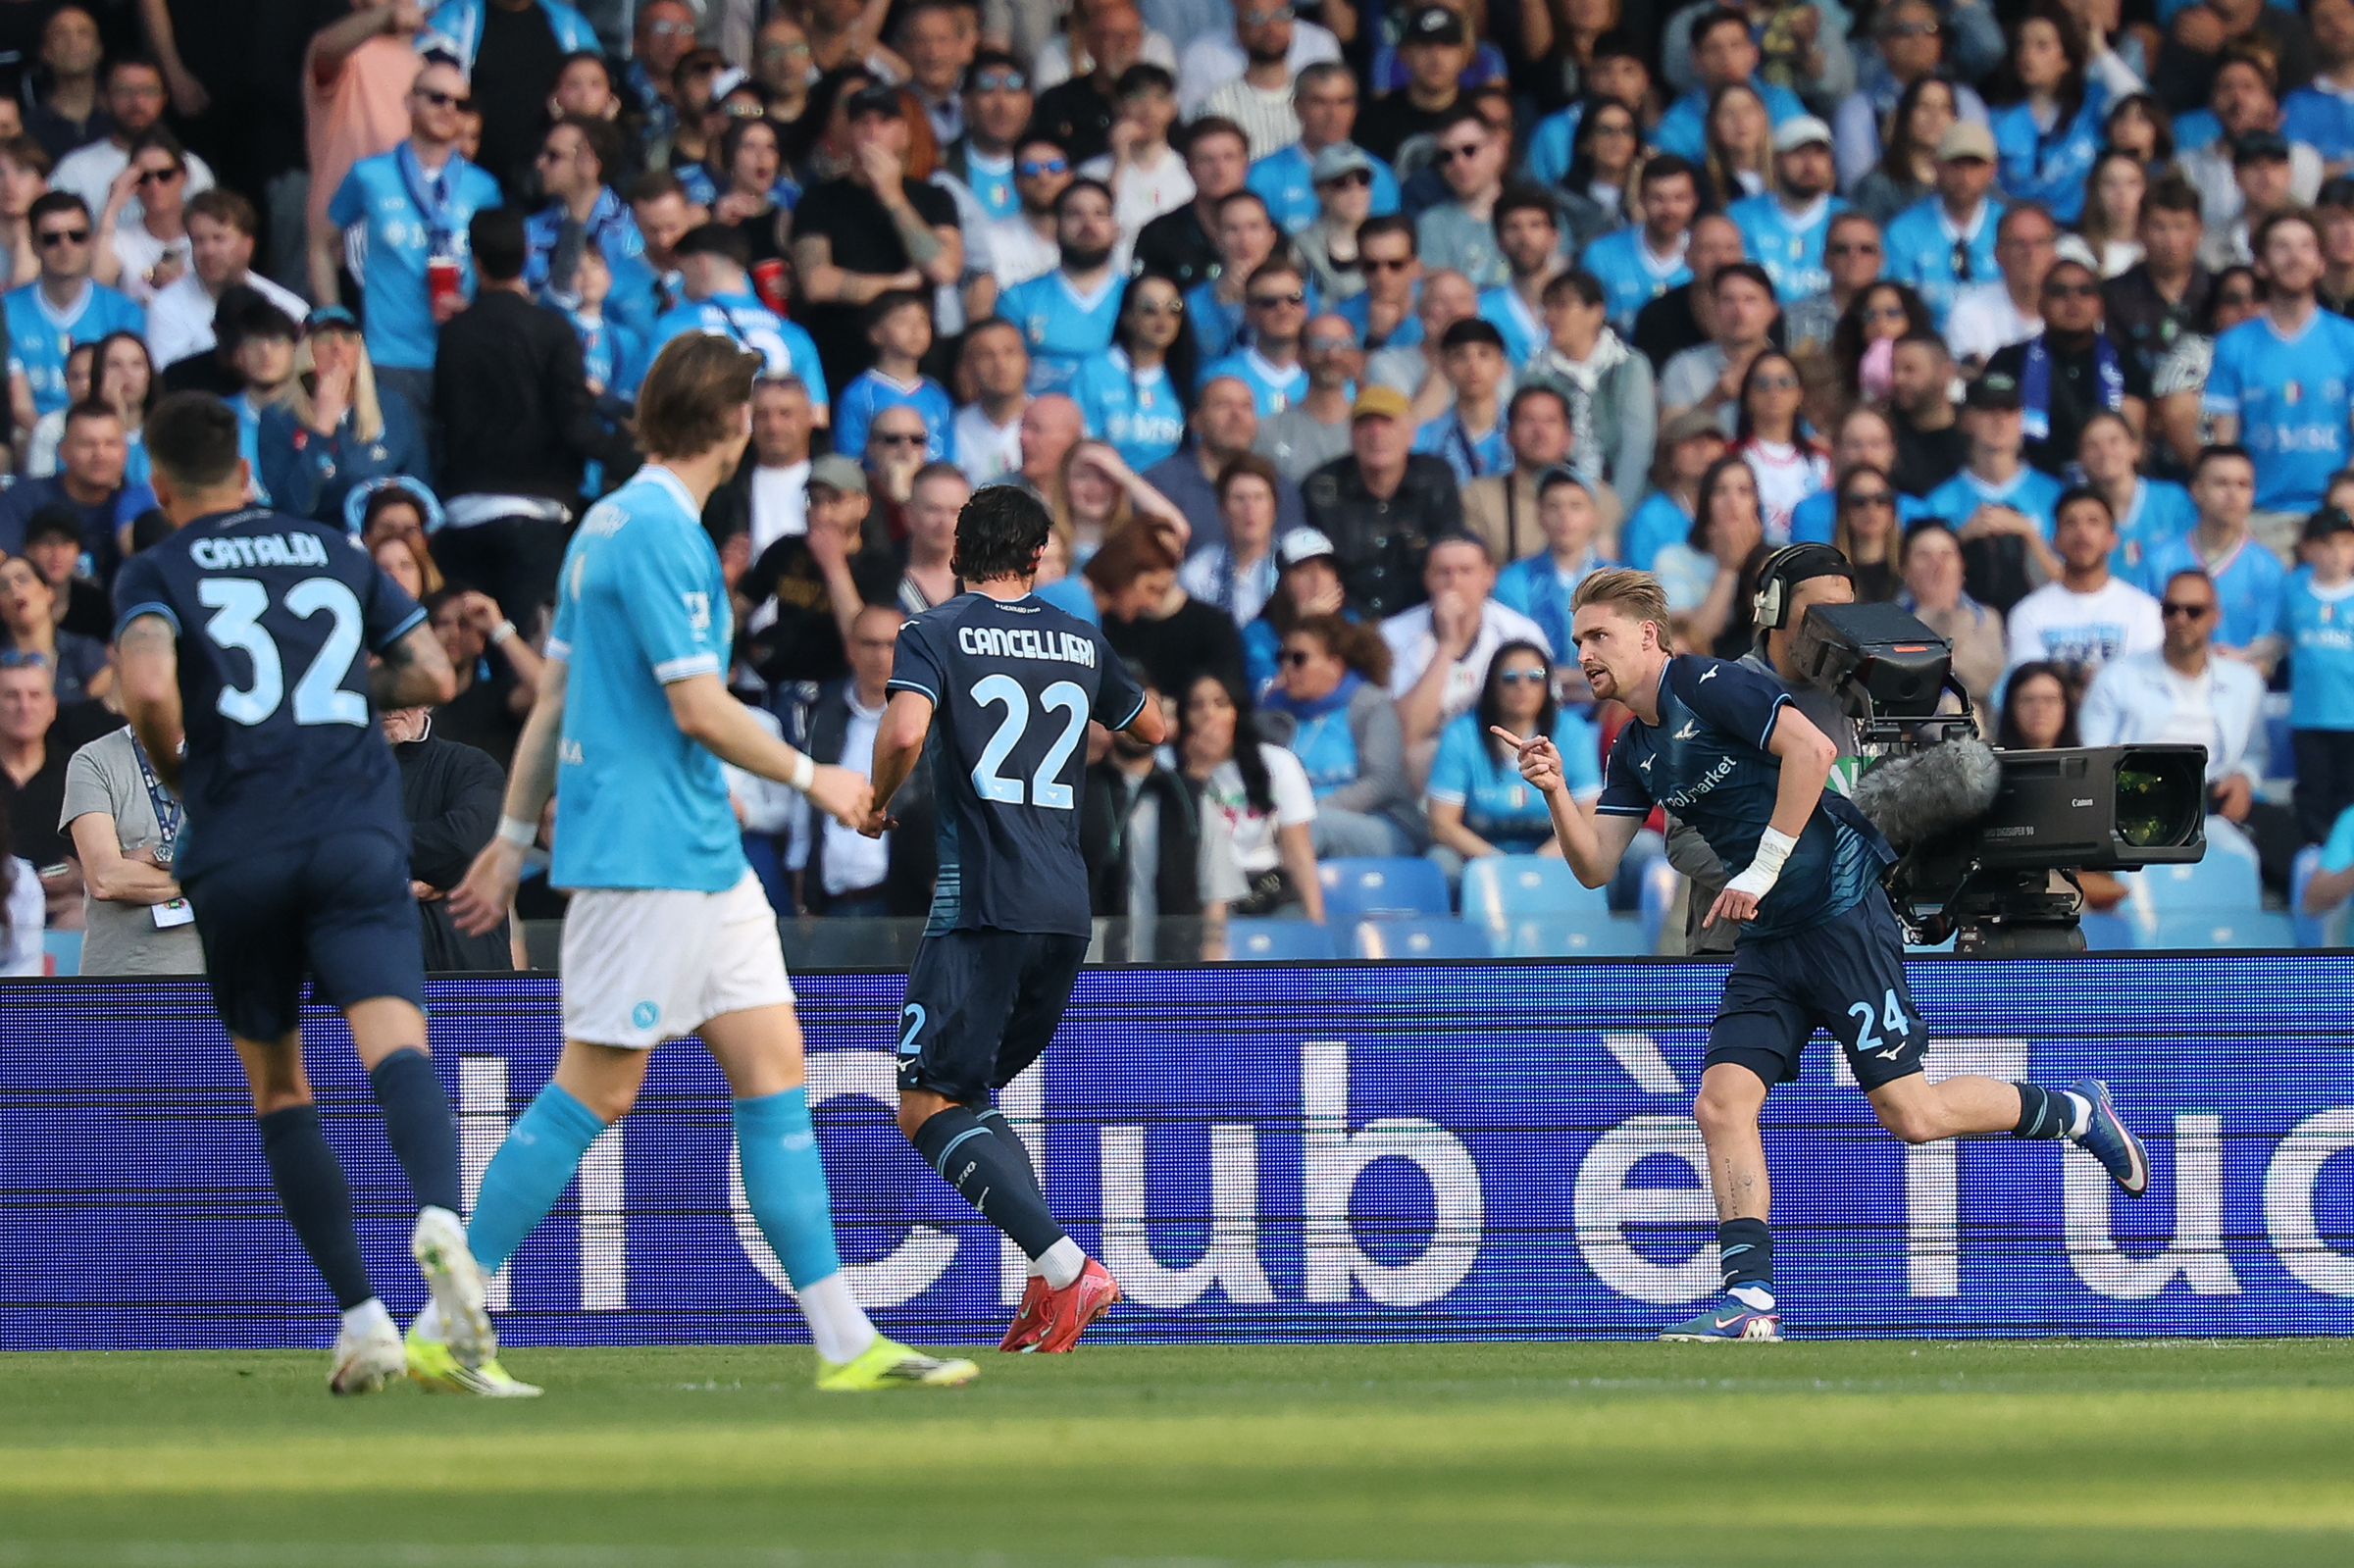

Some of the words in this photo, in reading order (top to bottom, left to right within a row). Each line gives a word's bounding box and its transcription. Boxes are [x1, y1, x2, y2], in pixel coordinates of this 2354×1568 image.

[189, 531, 330, 570] CATALDI
[197, 577, 371, 728] 32
[958, 627, 1096, 669] CANCELLIERI
[970, 674, 1091, 810] 22
[2072, 798, 2094, 808] Canon
[896, 1003, 926, 1054] 2
[1847, 988, 1910, 1051] 24
[730, 1039, 1485, 1309] Club
[1573, 1033, 1723, 1304] è
